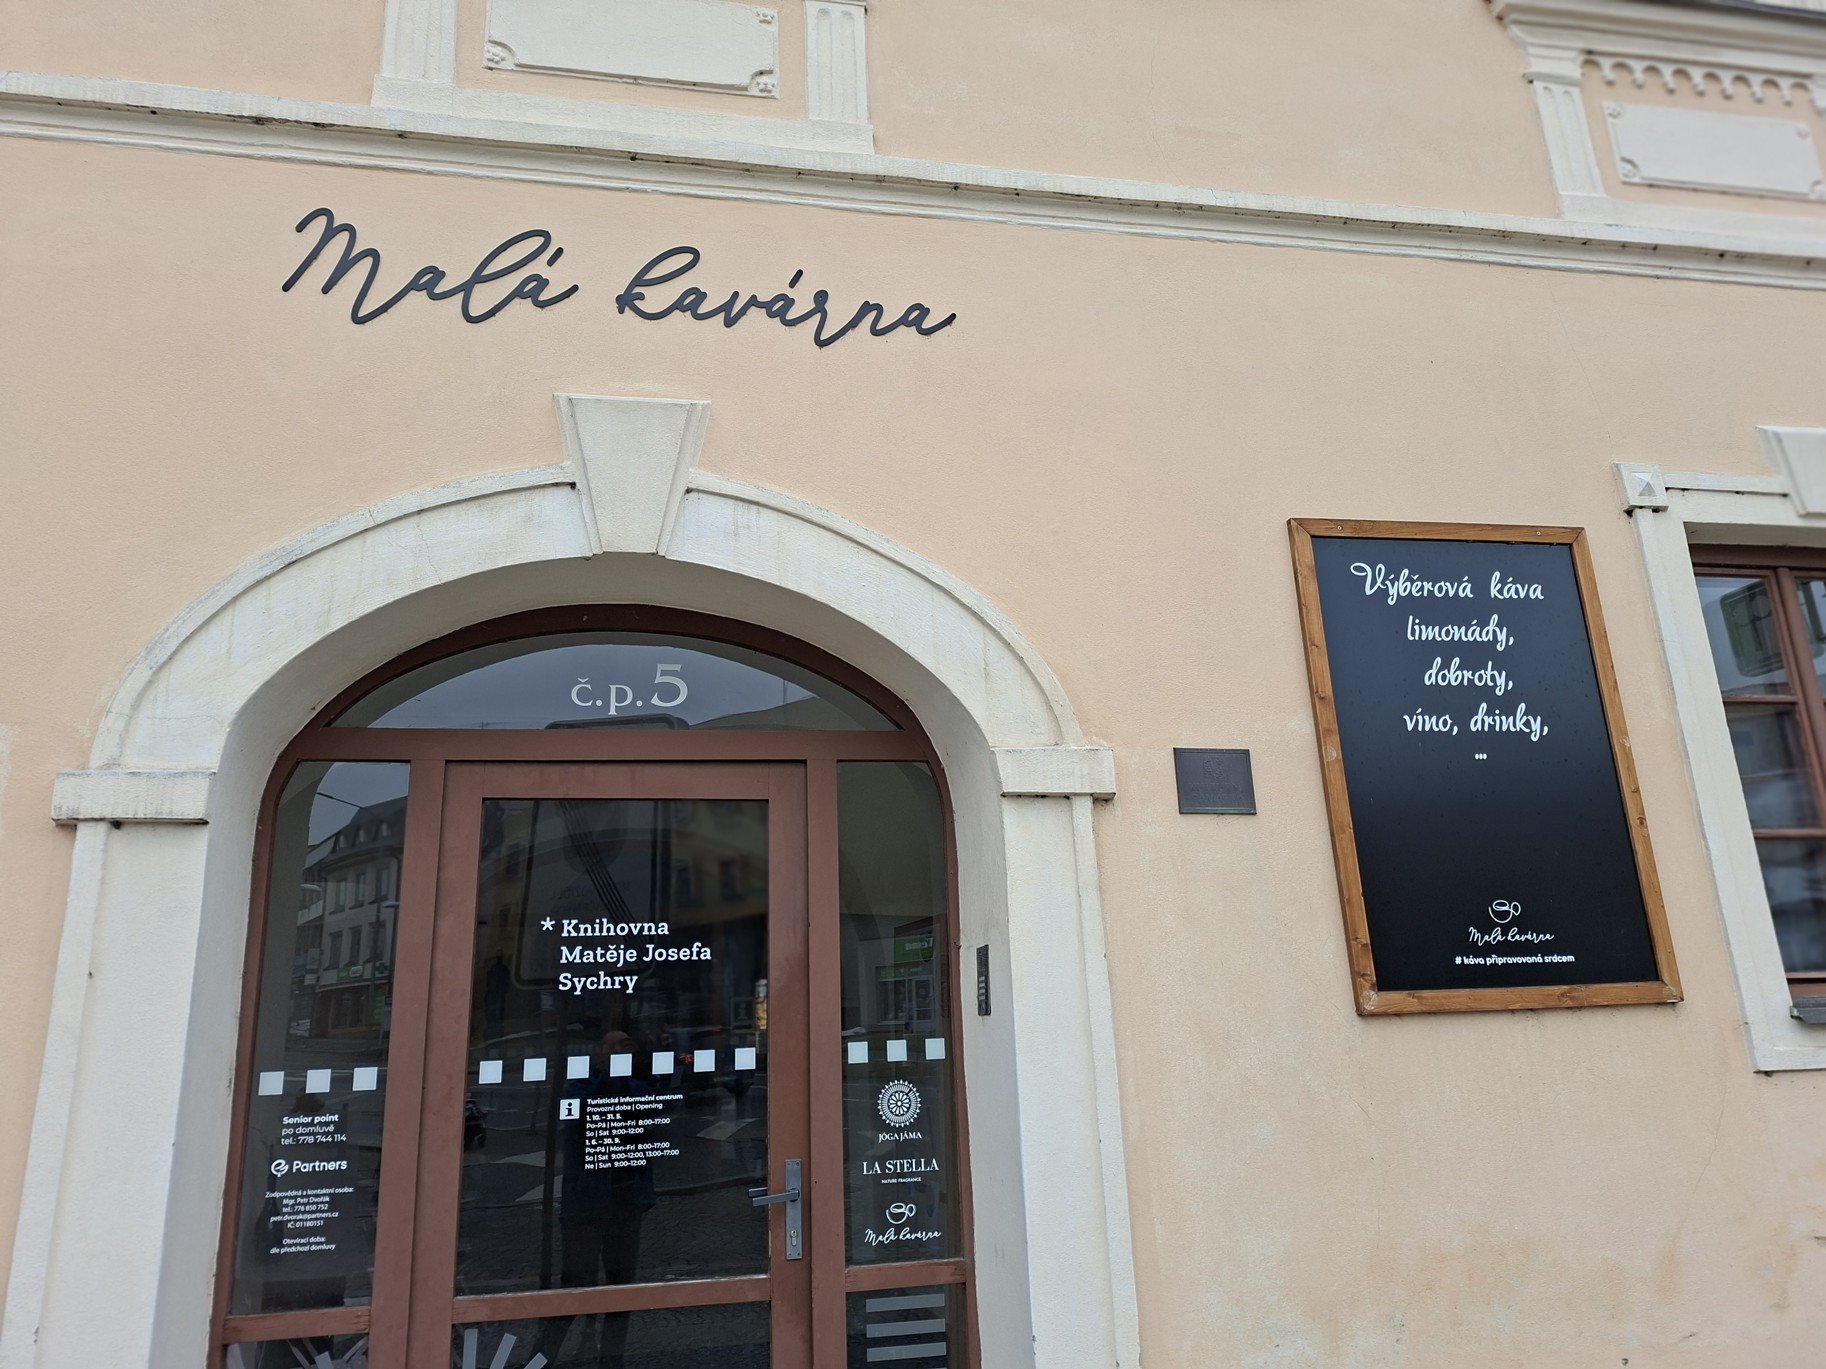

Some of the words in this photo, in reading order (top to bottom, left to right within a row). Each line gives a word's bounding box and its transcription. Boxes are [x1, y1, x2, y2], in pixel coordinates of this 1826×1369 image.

[282, 207, 579, 324] Malá
[616, 246, 956, 348] kavárna
[1350, 562, 1473, 605] Výběrová
[1490, 571, 1544, 600] káva
[1407, 614, 1514, 651] limonády,
[1424, 657, 1513, 696] dobroty,
[1403, 708, 1459, 736] víno,
[1470, 702, 1549, 742] drinky,
[562, 918, 669, 937] Knihovna
[1469, 927, 1505, 946] Malá
[1508, 927, 1554, 943] kavárna
[560, 944, 637, 966] Matěje
[643, 943, 711, 962] Josefa
[1464, 956, 1484, 964] káva
[1486, 954, 1542, 965] připravovaná
[1545, 955, 1575, 963] srdcem
[558, 972, 638, 995] Sychry
[587, 1097, 618, 1105] Turistické
[283, 1115, 313, 1124] Senior
[314, 1114, 339, 1124] point
[295, 1124, 334, 1133] domluvě
[879, 1132, 899, 1143] JÓGA
[900, 1131, 922, 1142] JÁMA
[281, 1137, 295, 1145] tel.:
[298, 1136, 314, 1144] 778
[316, 1135, 332, 1143] 744
[334, 1134, 346, 1142] 114
[293, 1161, 347, 1173] Partners
[863, 1162, 882, 1174] LA
[886, 1158, 939, 1173] STELLA
[281, 1245, 309, 1254] předchozí
